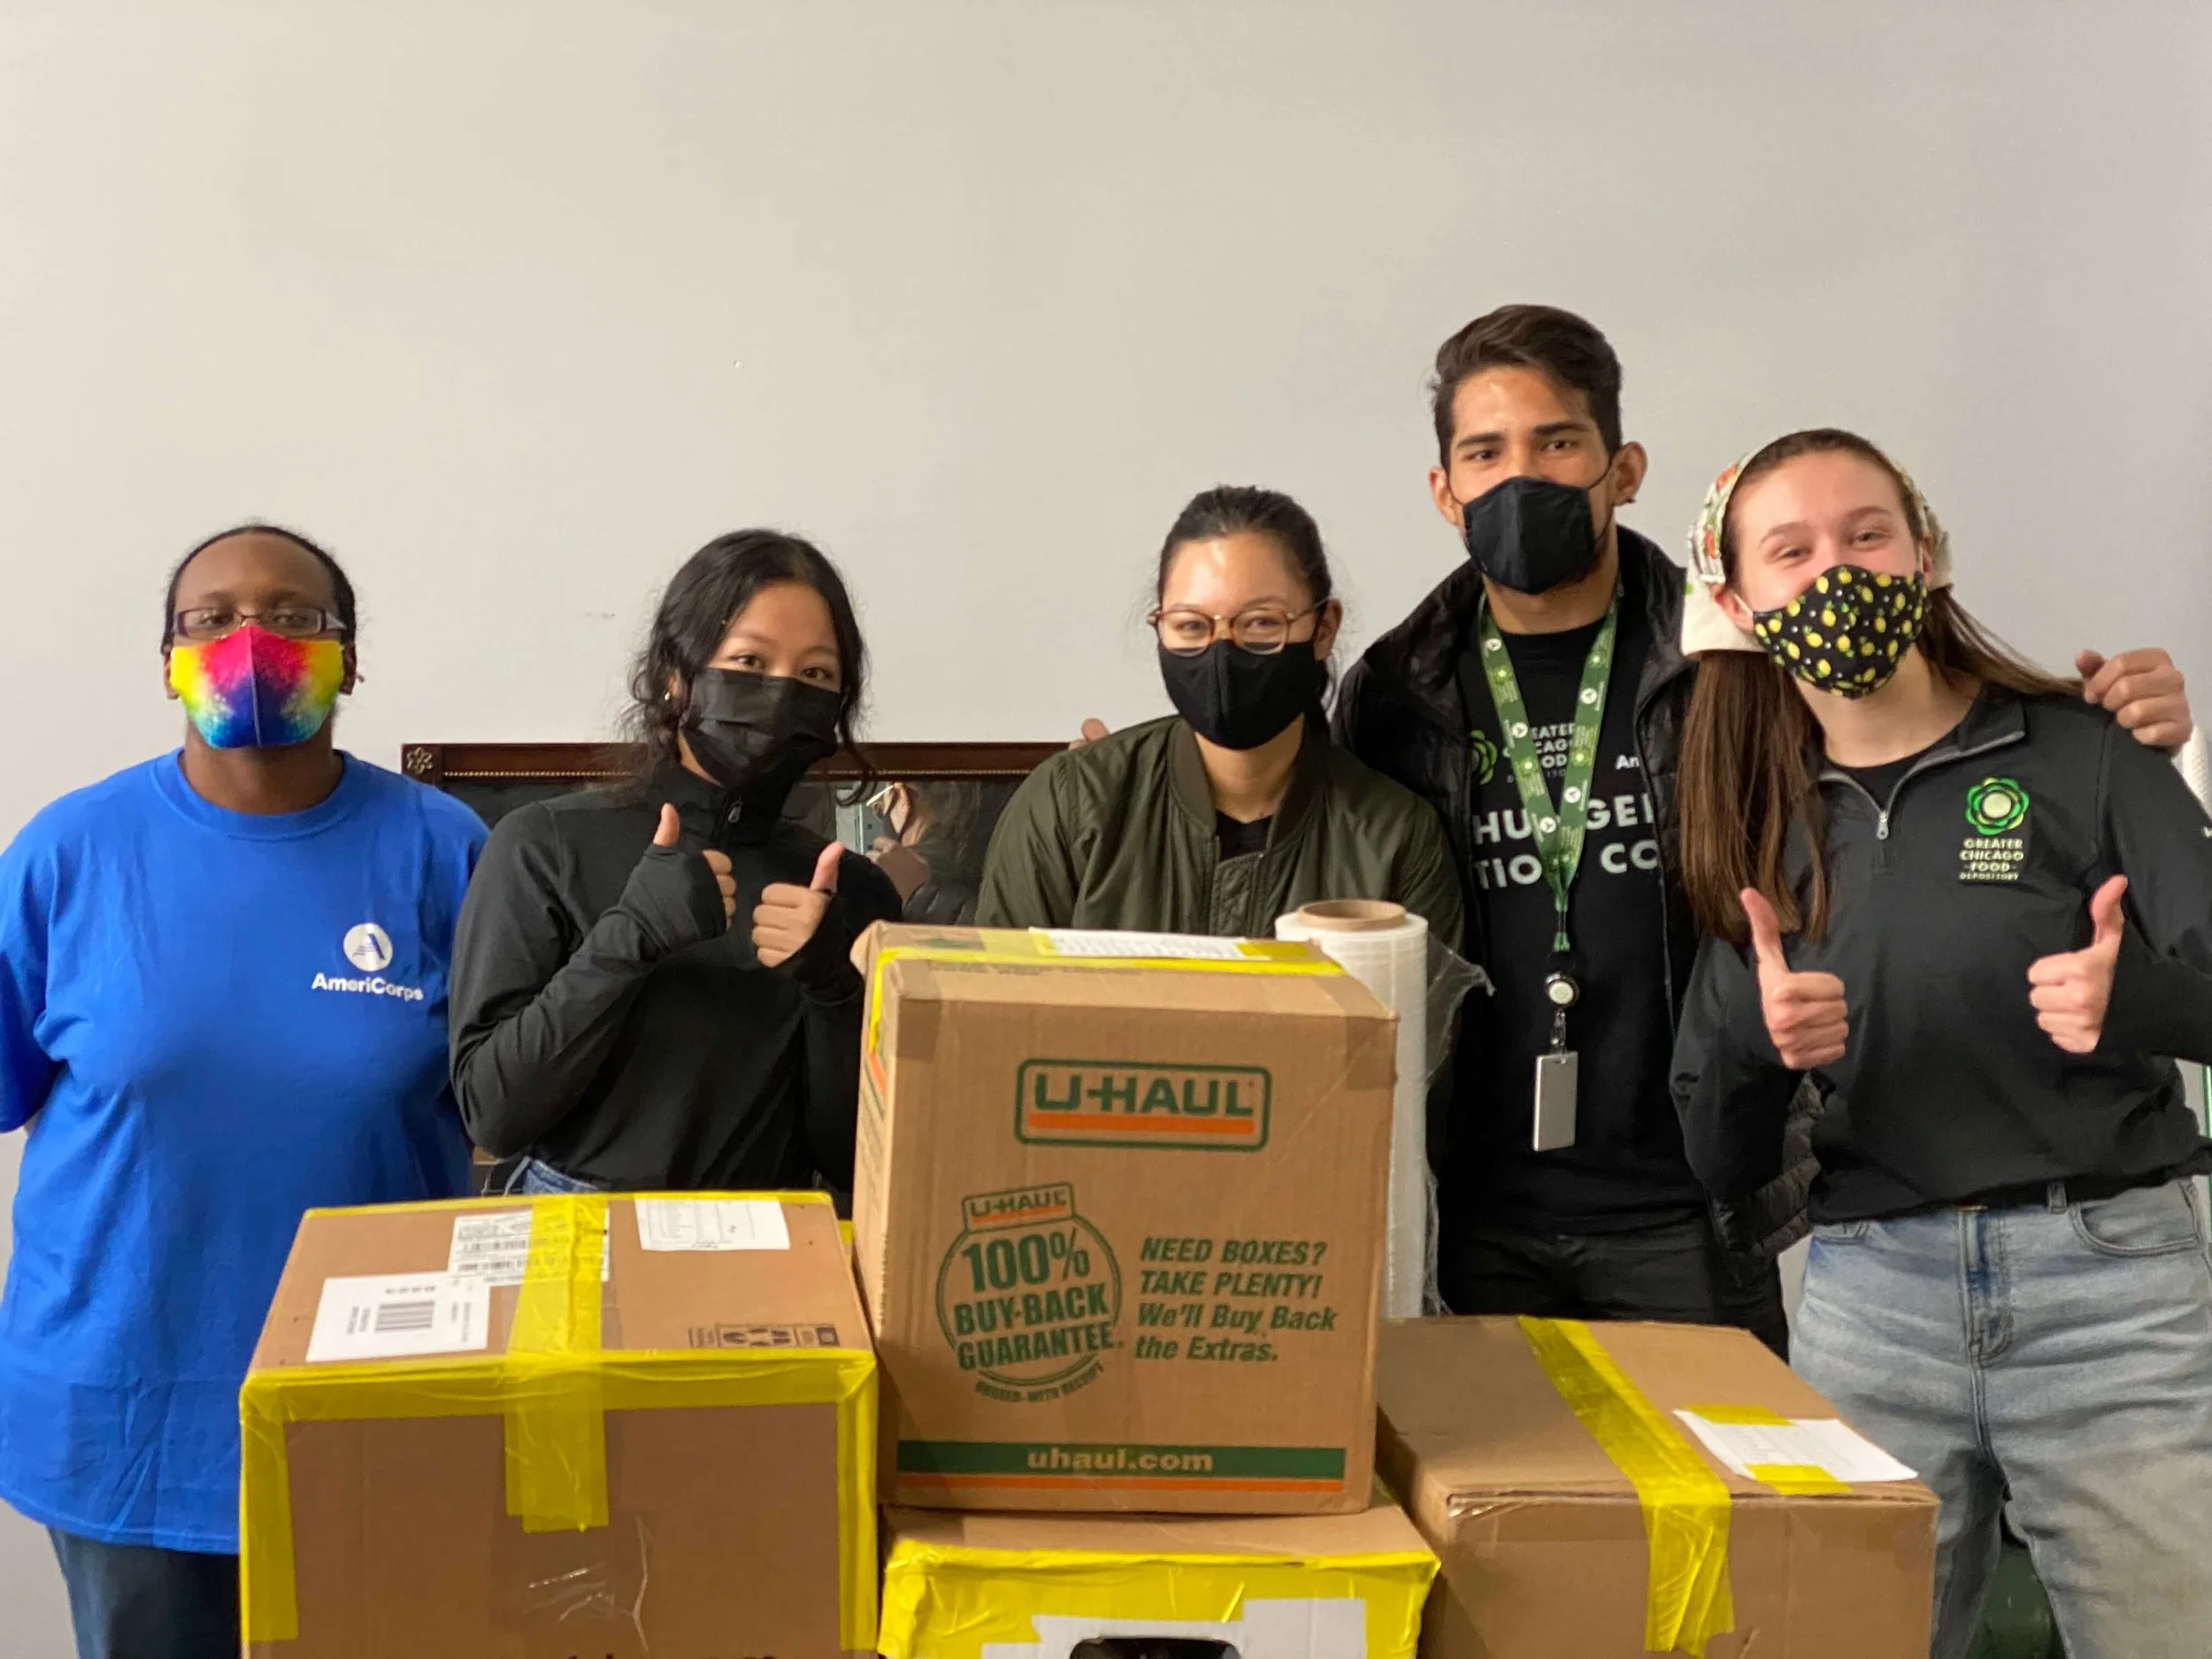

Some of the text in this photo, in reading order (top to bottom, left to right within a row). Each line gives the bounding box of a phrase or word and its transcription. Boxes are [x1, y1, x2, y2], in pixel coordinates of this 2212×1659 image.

[1959, 849, 2024, 861] CHICAGO
[1962, 838, 2024, 849] GREATER
[1970, 861, 2011, 872] FOOD
[311, 972, 425, 1002] AmeriCorps
[1033, 1071, 1255, 1118] U-HAUL
[970, 1191, 1068, 1217] U-HAUL
[961, 1227, 1091, 1294] 100%
[1139, 1237, 1328, 1266] NEED BOXES?
[1140, 1269, 1324, 1300] TAKE PLENTY!
[953, 1282, 1110, 1337] BUY-BACK
[1137, 1302, 1339, 1334] We'll Buy Back
[1134, 1334, 1279, 1363] the Extras.
[1025, 1446, 1215, 1473] uhaul.com
